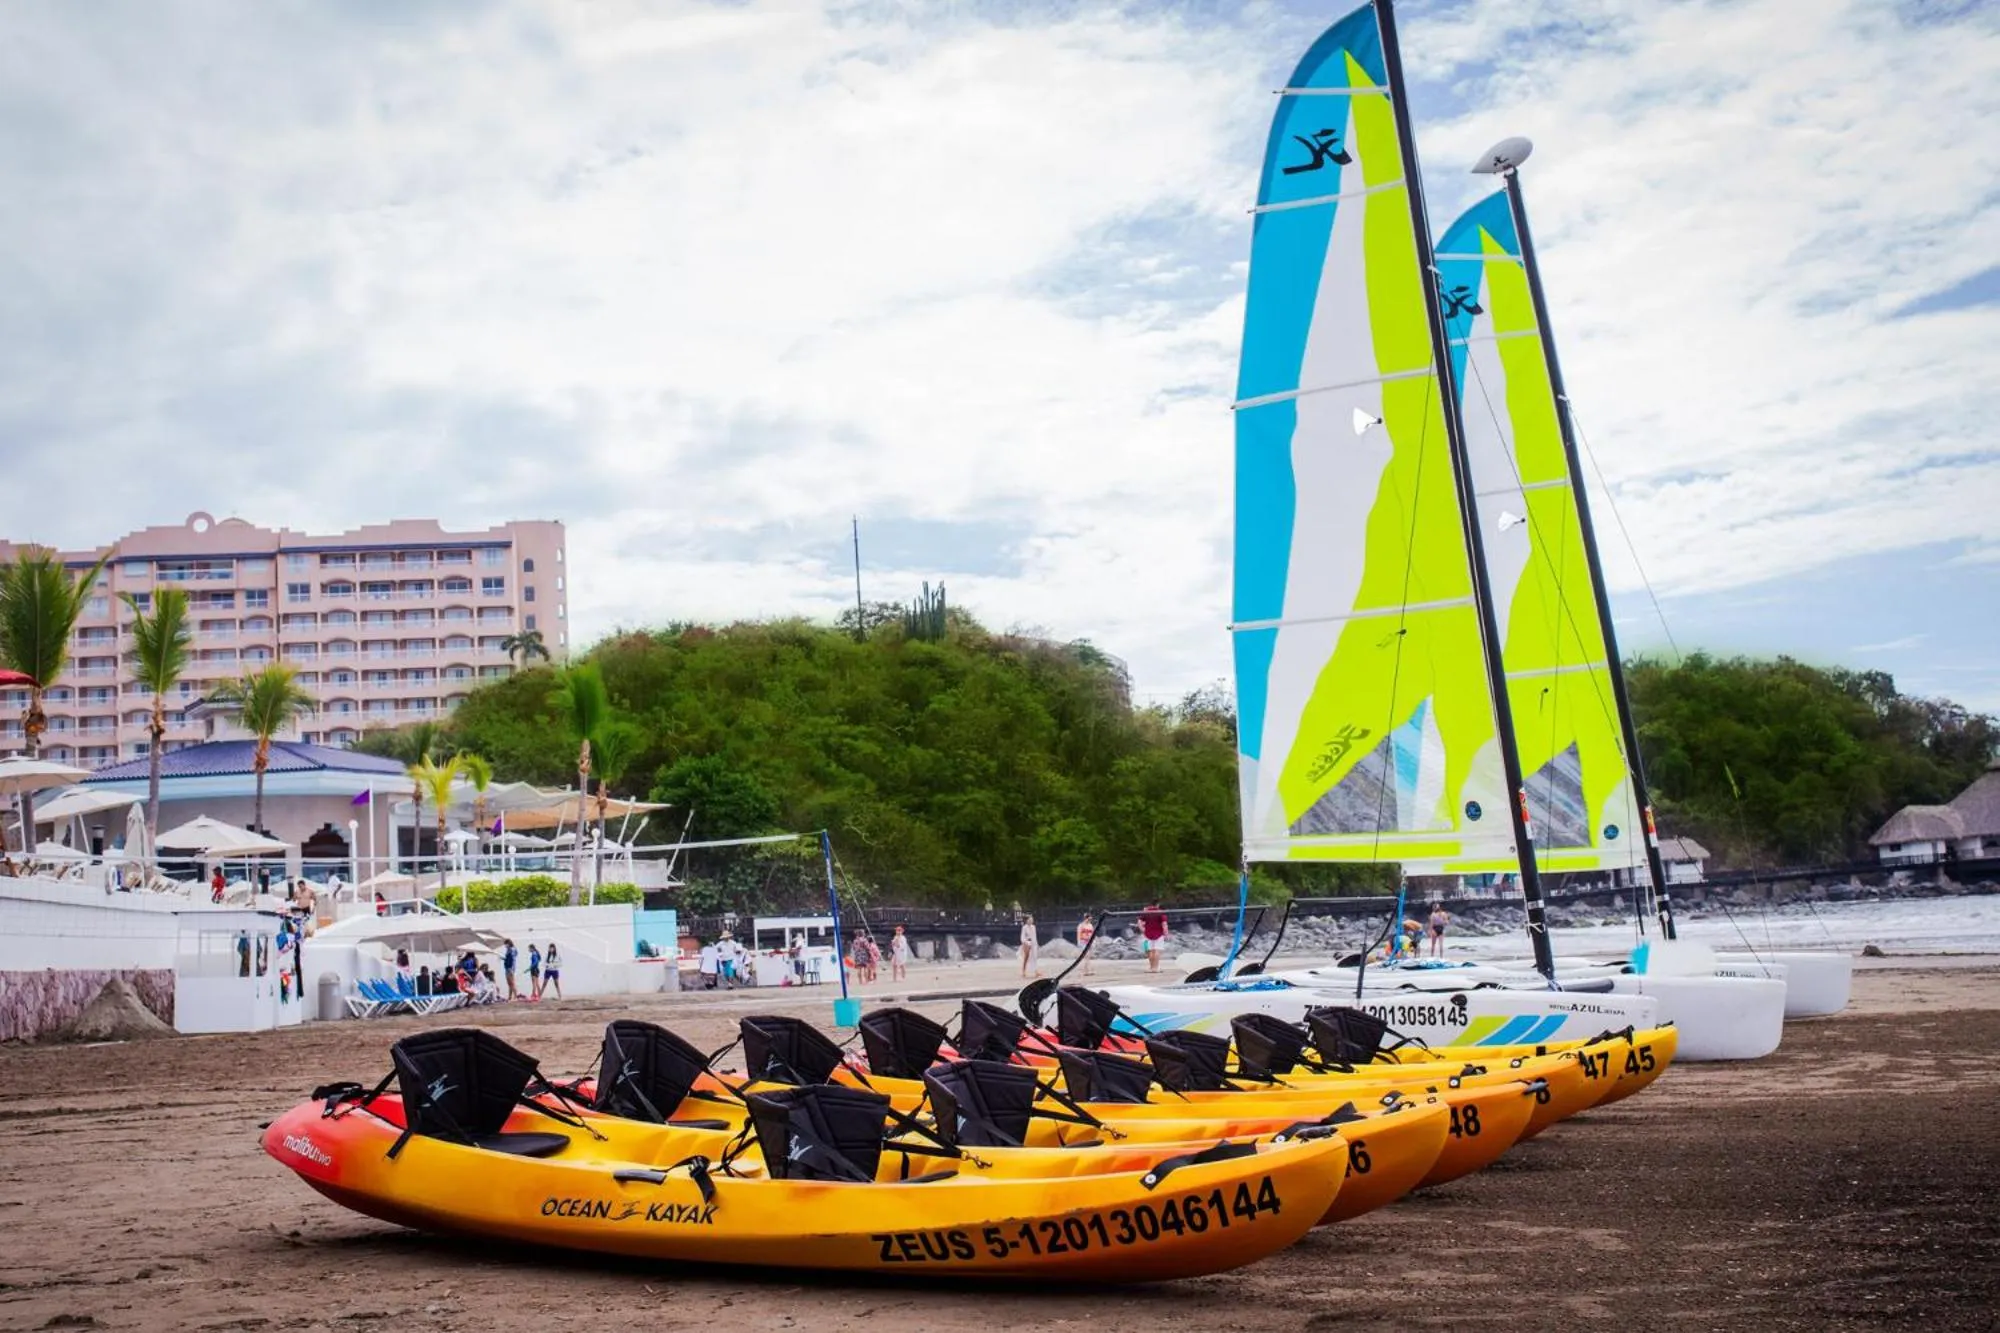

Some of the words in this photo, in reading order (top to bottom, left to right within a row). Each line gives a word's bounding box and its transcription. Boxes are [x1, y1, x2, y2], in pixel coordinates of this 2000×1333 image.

[1571, 1003, 1603, 1014] AZUL
[1625, 1045, 1655, 1075] 45
[1449, 1104, 1481, 1139] 48
[282, 1134, 318, 1160] malibu
[1345, 1140, 1371, 1177] 6
[541, 1198, 612, 1219] OCEAN
[645, 1202, 720, 1225] KAYAK
[872, 1231, 976, 1262] ZEUS
[983, 1175, 1281, 1259] 5-12013046144
